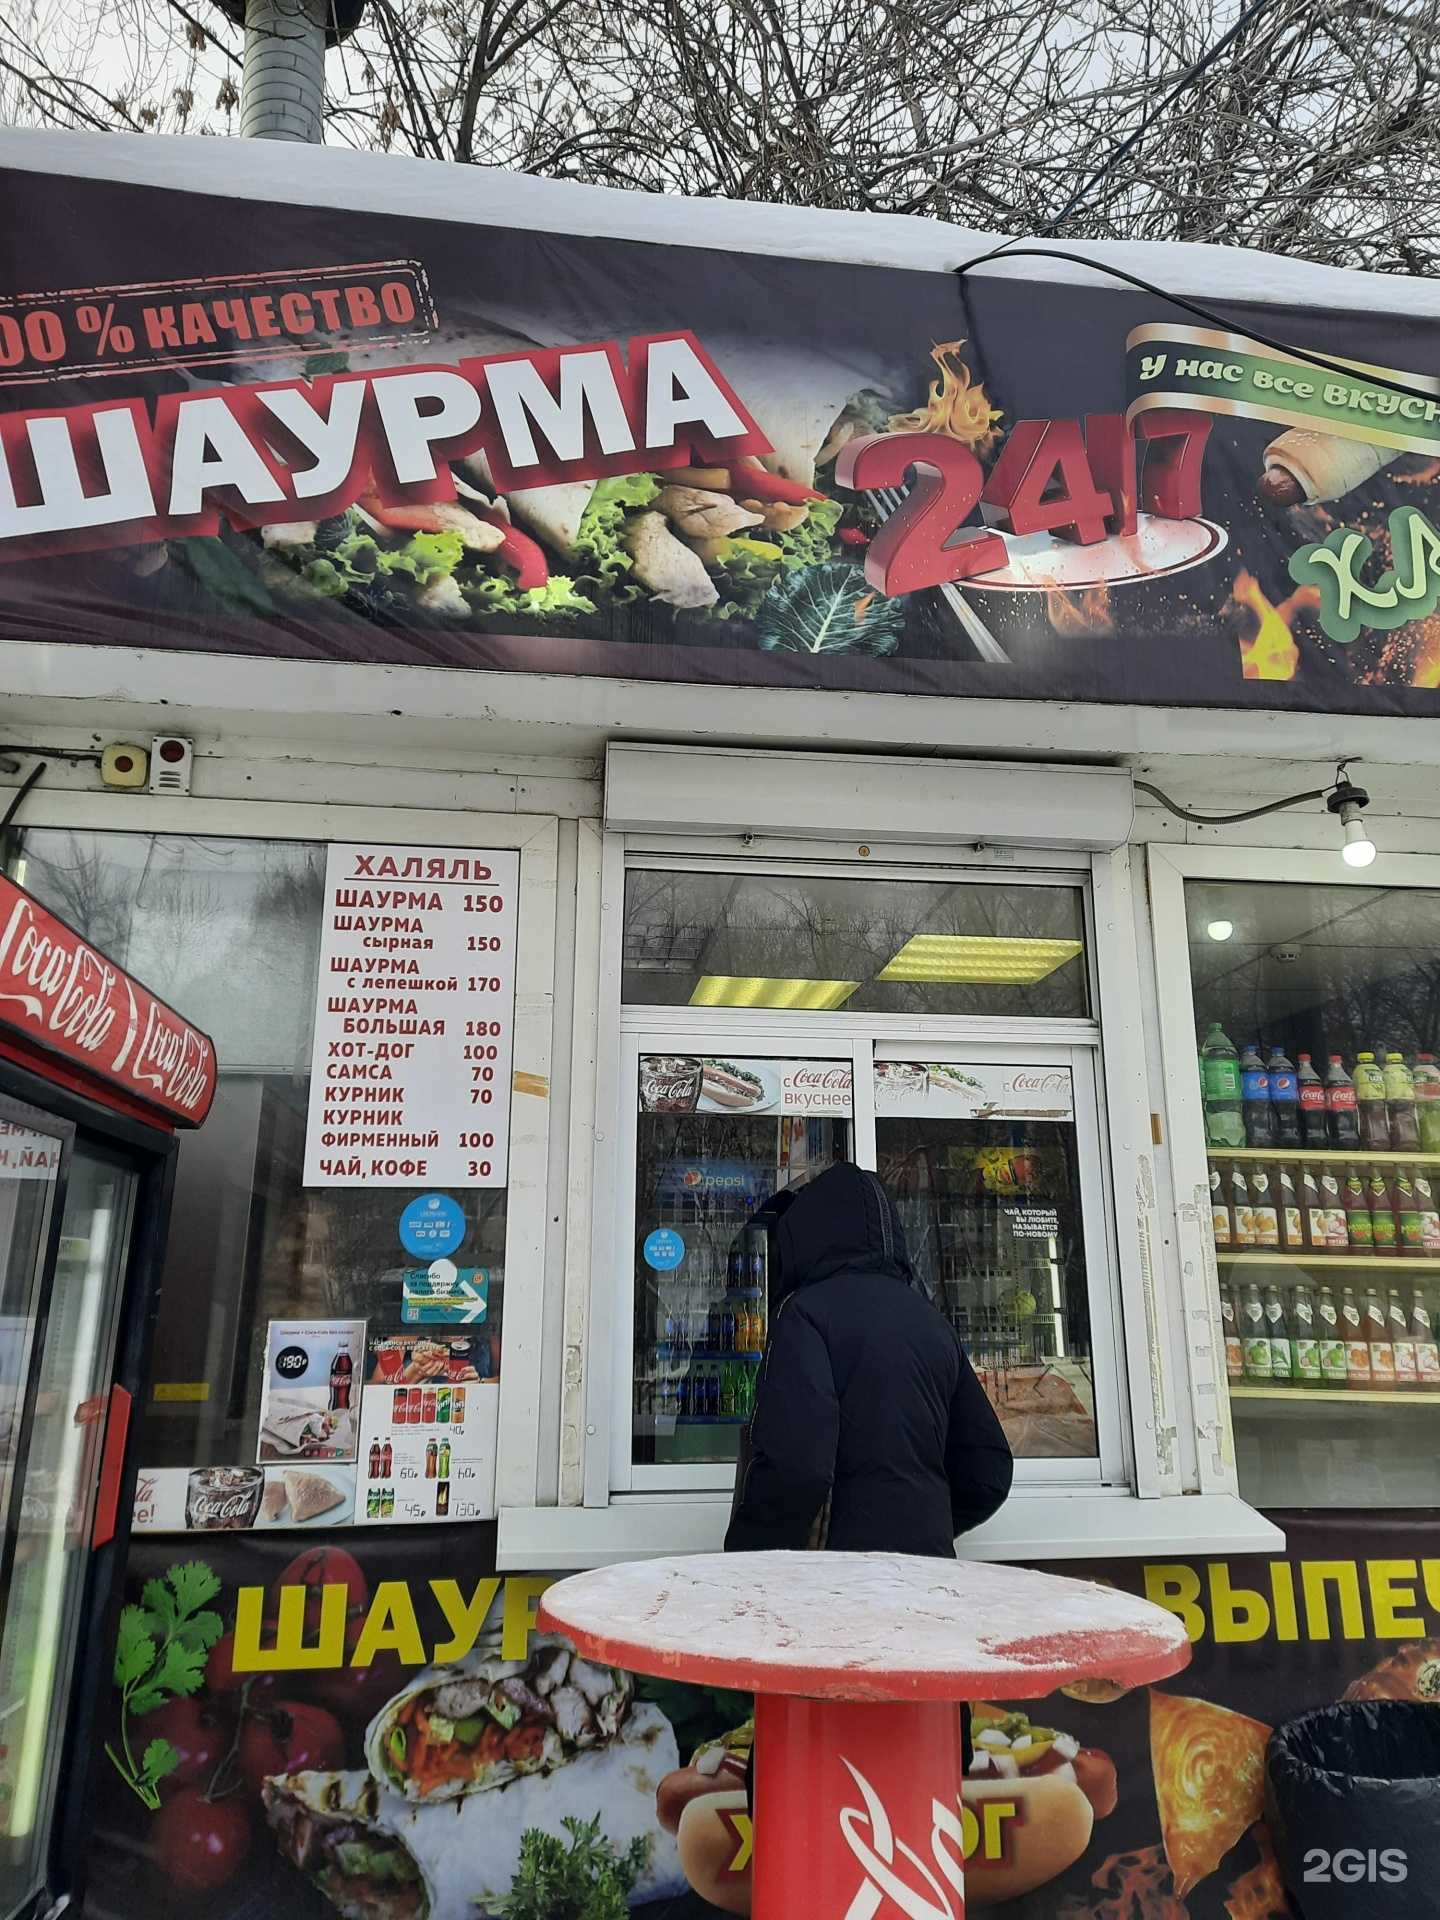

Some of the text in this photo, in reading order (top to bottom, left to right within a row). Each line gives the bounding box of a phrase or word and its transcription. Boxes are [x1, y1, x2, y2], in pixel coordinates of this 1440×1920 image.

[75, 303, 136, 357] %
[143, 281, 417, 349] КАЧЕСТВО
[1175, 358, 1244, 382] нас
[1253, 370, 1314, 399] все
[0, 337, 748, 540] ШАУРМА
[354, 855, 492, 880] ХАЛЯЛЬ
[335, 889, 503, 913] ШАУРМА 150
[333, 915, 424, 933] ШАУРМА
[363, 936, 501, 952] сырная 150
[330, 957, 420, 974] ШАУРМА
[0, 898, 116, 1052] Coca-Cola
[347, 975, 500, 992] с лепешкой 170
[328, 997, 418, 1014] ШАУРМА
[343, 1018, 500, 1036] БОЛЬШАЯ 180
[132, 1001, 208, 1111] Coca-Cola
[328, 1042, 498, 1061] ХОТ-ДОГ 100
[326, 1064, 494, 1082] САМСА 70
[793, 1067, 852, 1089] Coca-Cola
[324, 1087, 492, 1104] КУРНИК 70
[645, 1078, 695, 1099] Coca-Cola
[323, 1110, 403, 1125] КУРНИК
[321, 1131, 494, 1148] ФИРМЕННЫЙ 100
[371, 1160, 427, 1177] КОФЕ
[468, 1161, 491, 1177] 30
[705, 1174, 745, 1190] pepsi
[1004, 1207, 1057, 1217] ЧАЙ, КОТОРЫЙ
[1028, 1217, 1060, 1225] ЛЮБИТЕ,
[1012, 1223, 1058, 1231] НАЗЫВАЕТСЯ
[195, 1489, 256, 1519] Coca-Cola
